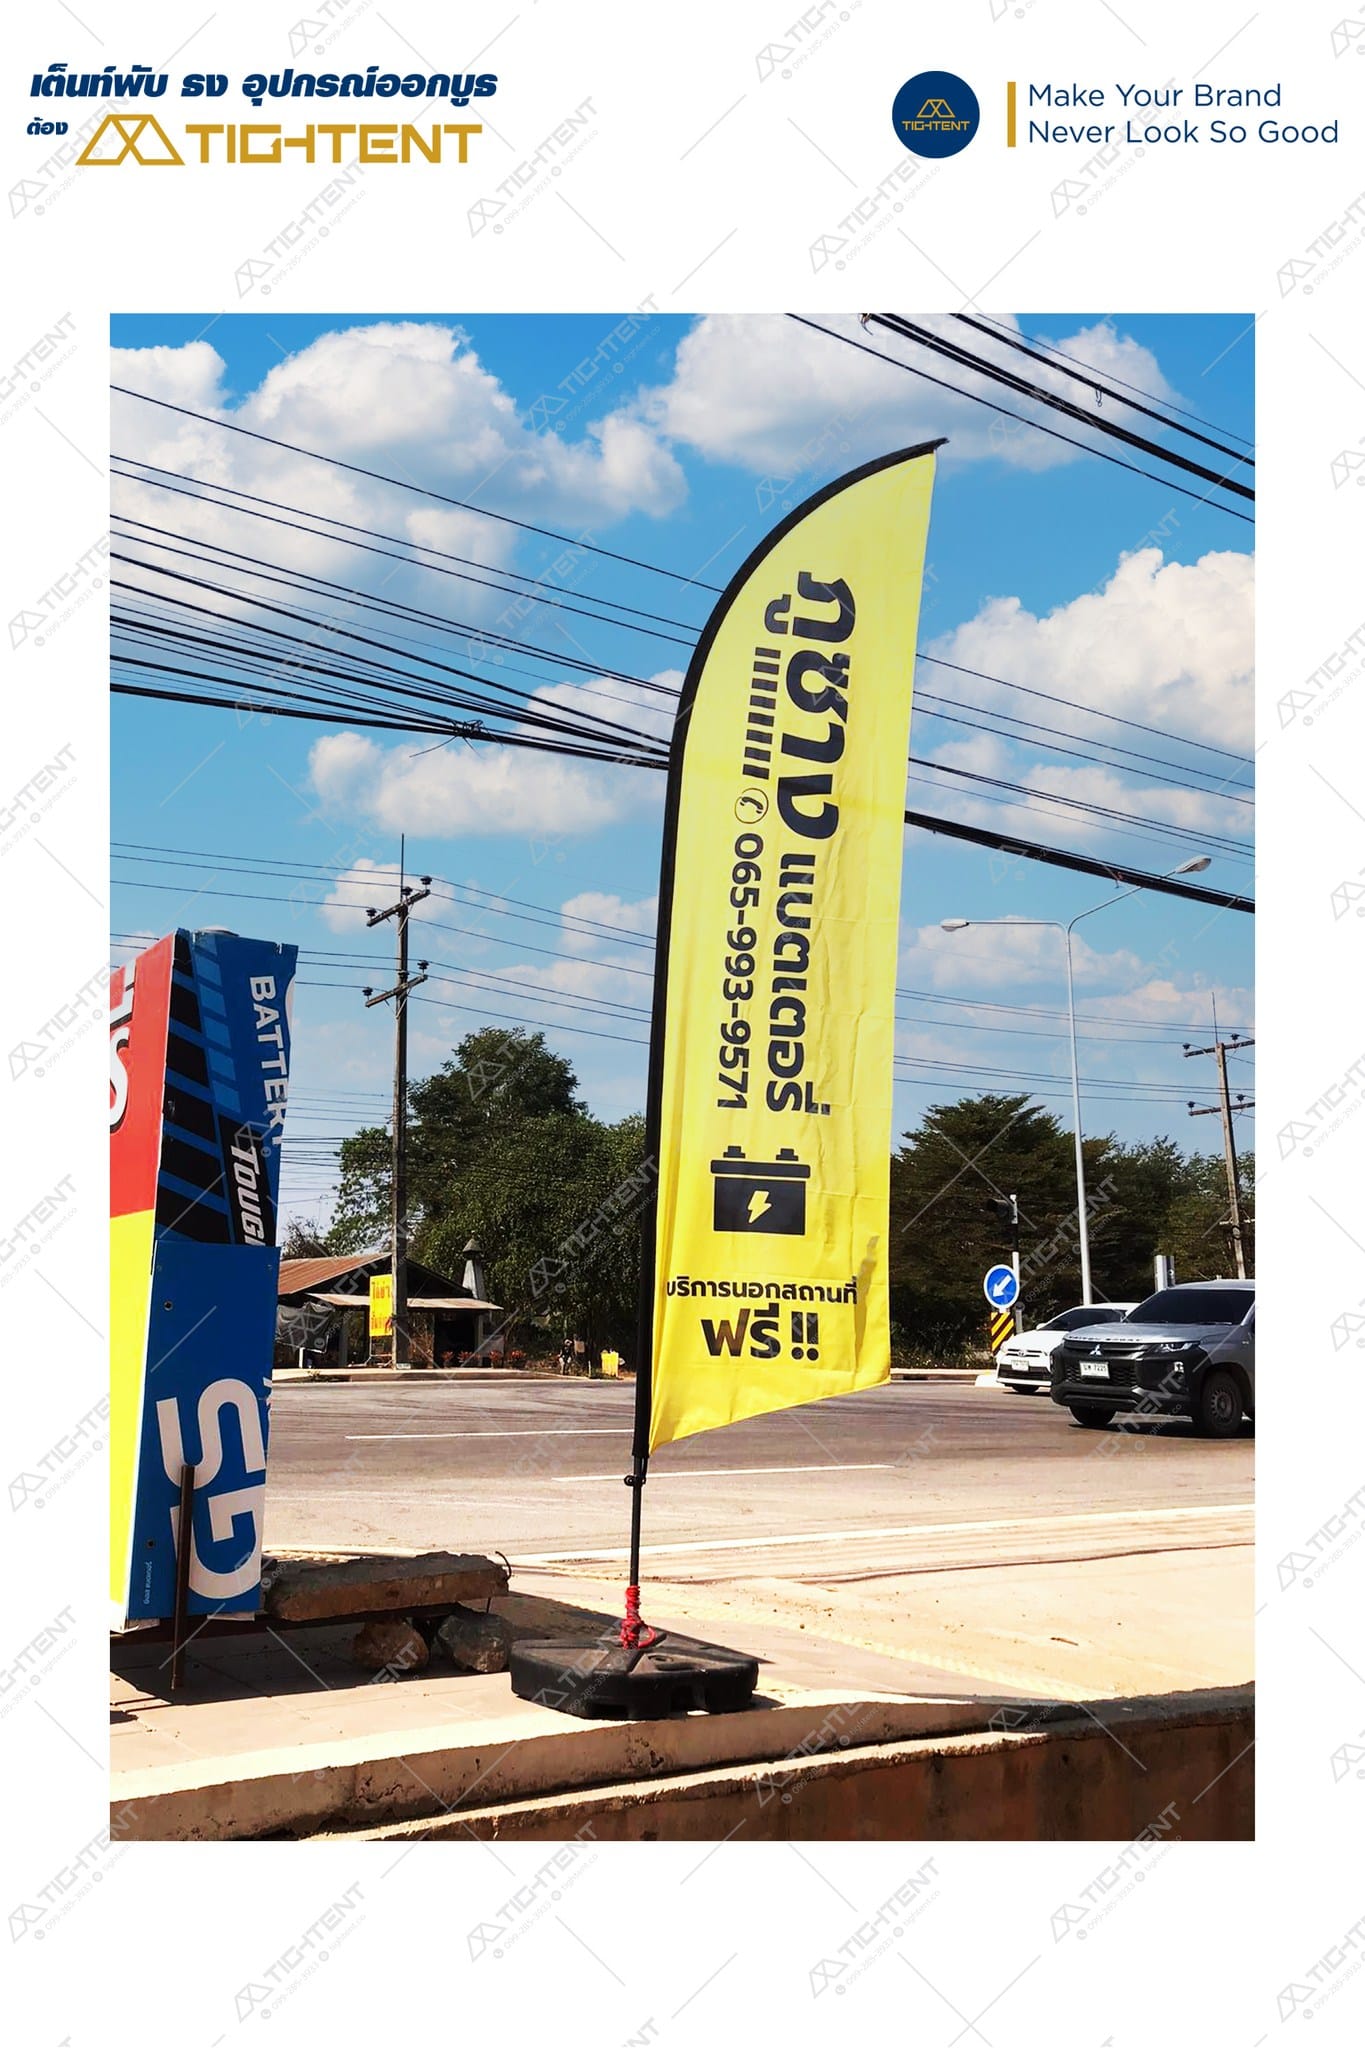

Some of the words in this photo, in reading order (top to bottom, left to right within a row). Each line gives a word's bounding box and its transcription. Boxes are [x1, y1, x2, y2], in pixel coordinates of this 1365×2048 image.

[717, 833, 764, 1110] 065-993-9571
[766, 853, 831, 1115] แบตเตอรี่
[666, 1275, 858, 1306] บริการนอกสถานที่
